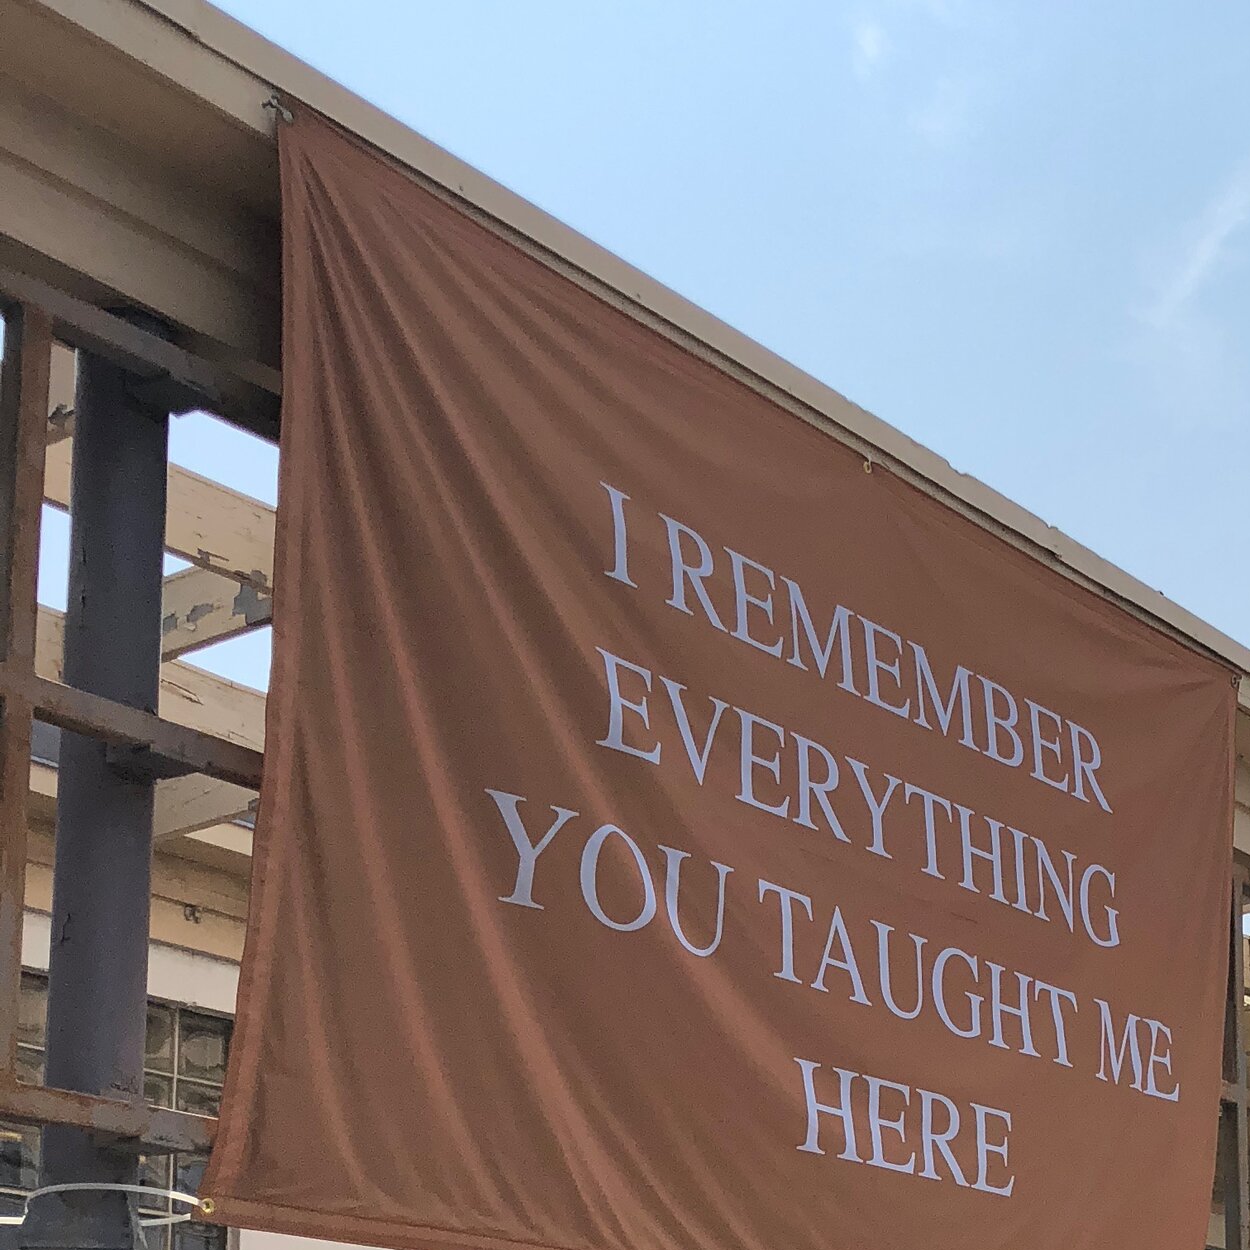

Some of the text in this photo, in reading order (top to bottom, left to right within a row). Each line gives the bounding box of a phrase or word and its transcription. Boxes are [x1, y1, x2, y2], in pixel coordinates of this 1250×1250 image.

[595, 647, 1120, 947] EVERYTHING
[601, 481, 1113, 814] I REMEMBER
[485, 789, 1180, 1101] YOU TAUGHT ME
[794, 1057, 1015, 1197] HERE
